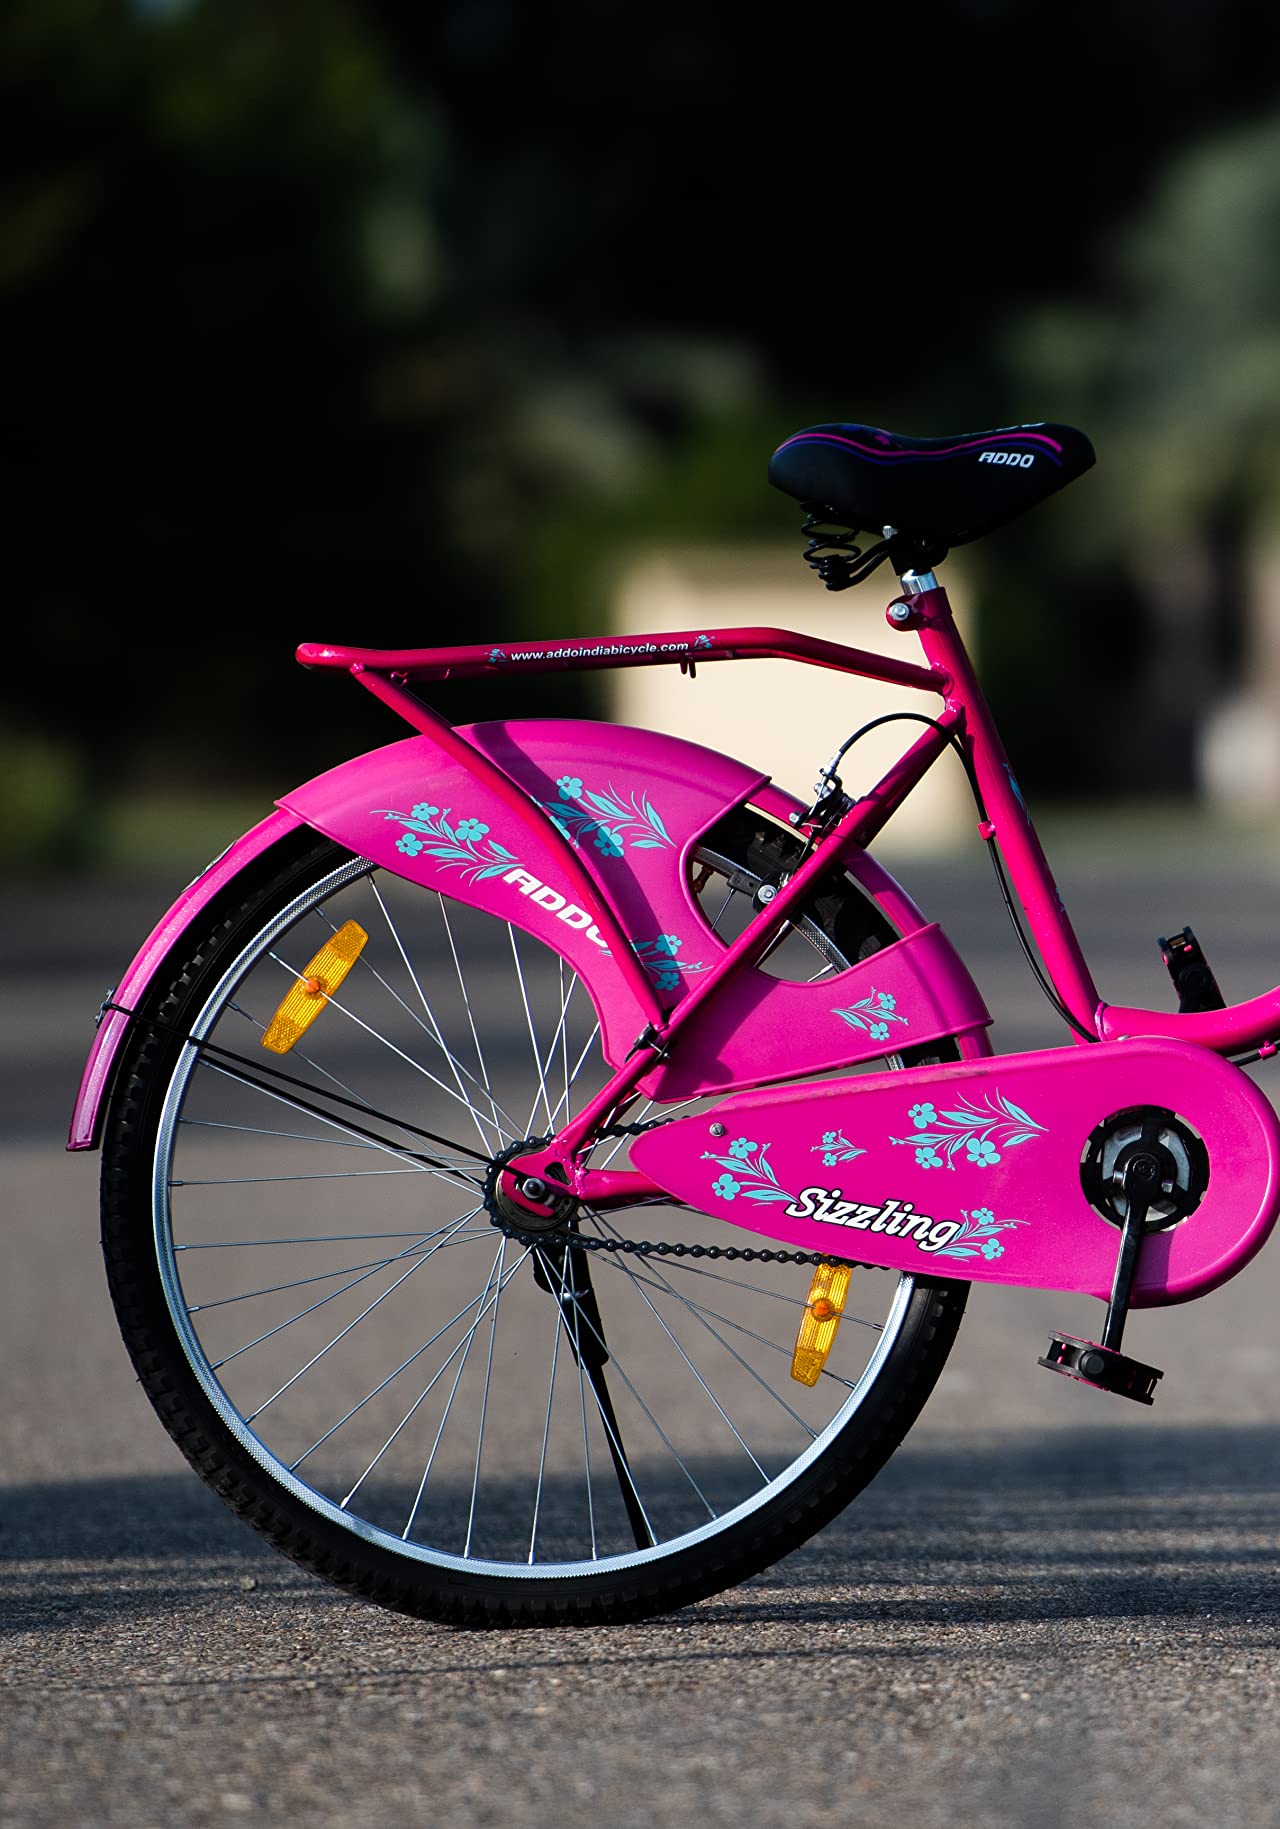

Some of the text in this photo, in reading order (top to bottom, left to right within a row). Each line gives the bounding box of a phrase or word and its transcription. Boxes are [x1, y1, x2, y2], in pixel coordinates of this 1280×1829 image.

[978, 451, 1035, 468] ADDO
[511, 641, 689, 661] www.addoindiabicycle.com
[784, 1186, 962, 1252] Sizzling
